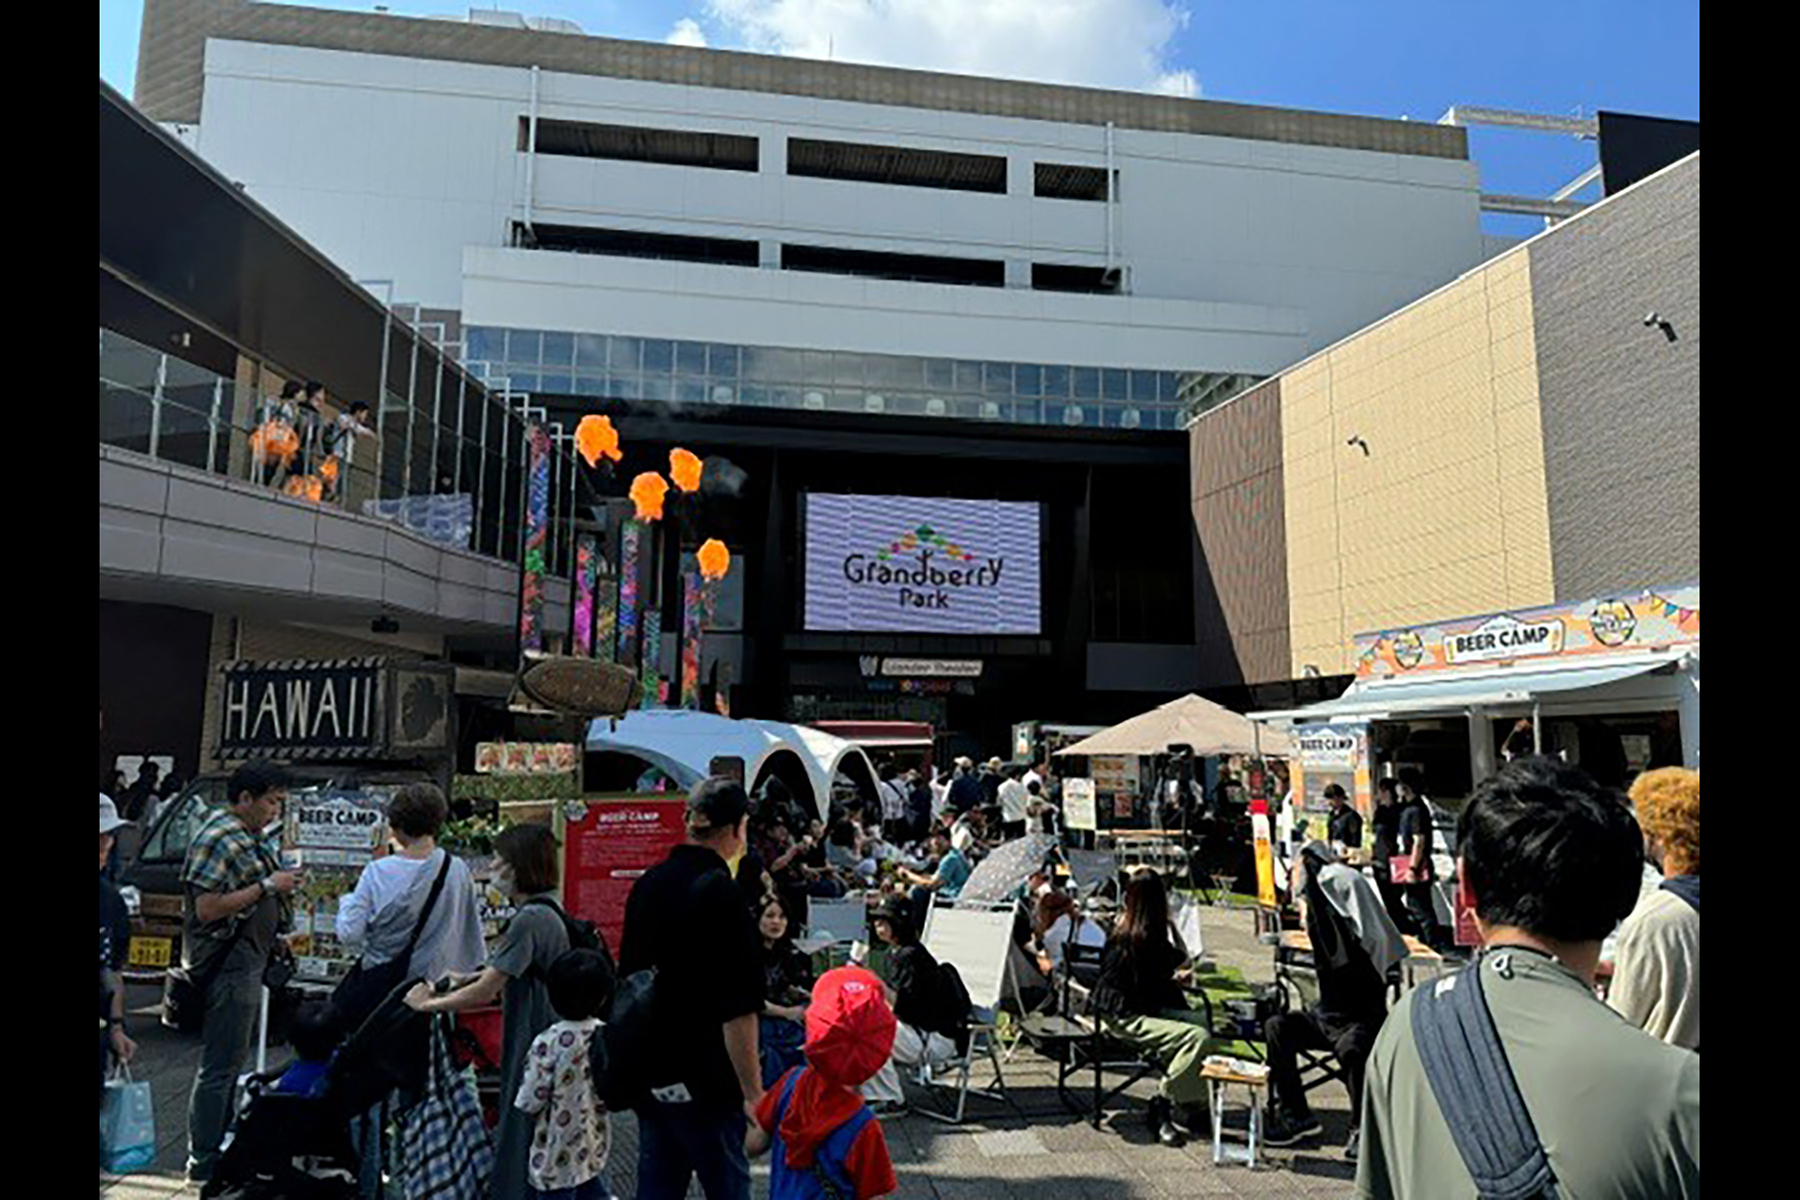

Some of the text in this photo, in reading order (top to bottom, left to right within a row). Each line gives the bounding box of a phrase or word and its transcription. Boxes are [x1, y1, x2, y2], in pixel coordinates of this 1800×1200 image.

[843, 550, 1004, 587] Grandberry
[899, 588, 949, 609] Park
[1456, 630, 1496, 653] BEER
[1498, 625, 1549, 647] CAMP
[225, 677, 371, 740] HAWAII
[1300, 738, 1353, 751] BEER CAMP
[300, 810, 378, 826] BEER CAMP
[629, 811, 659, 821] CAMP
